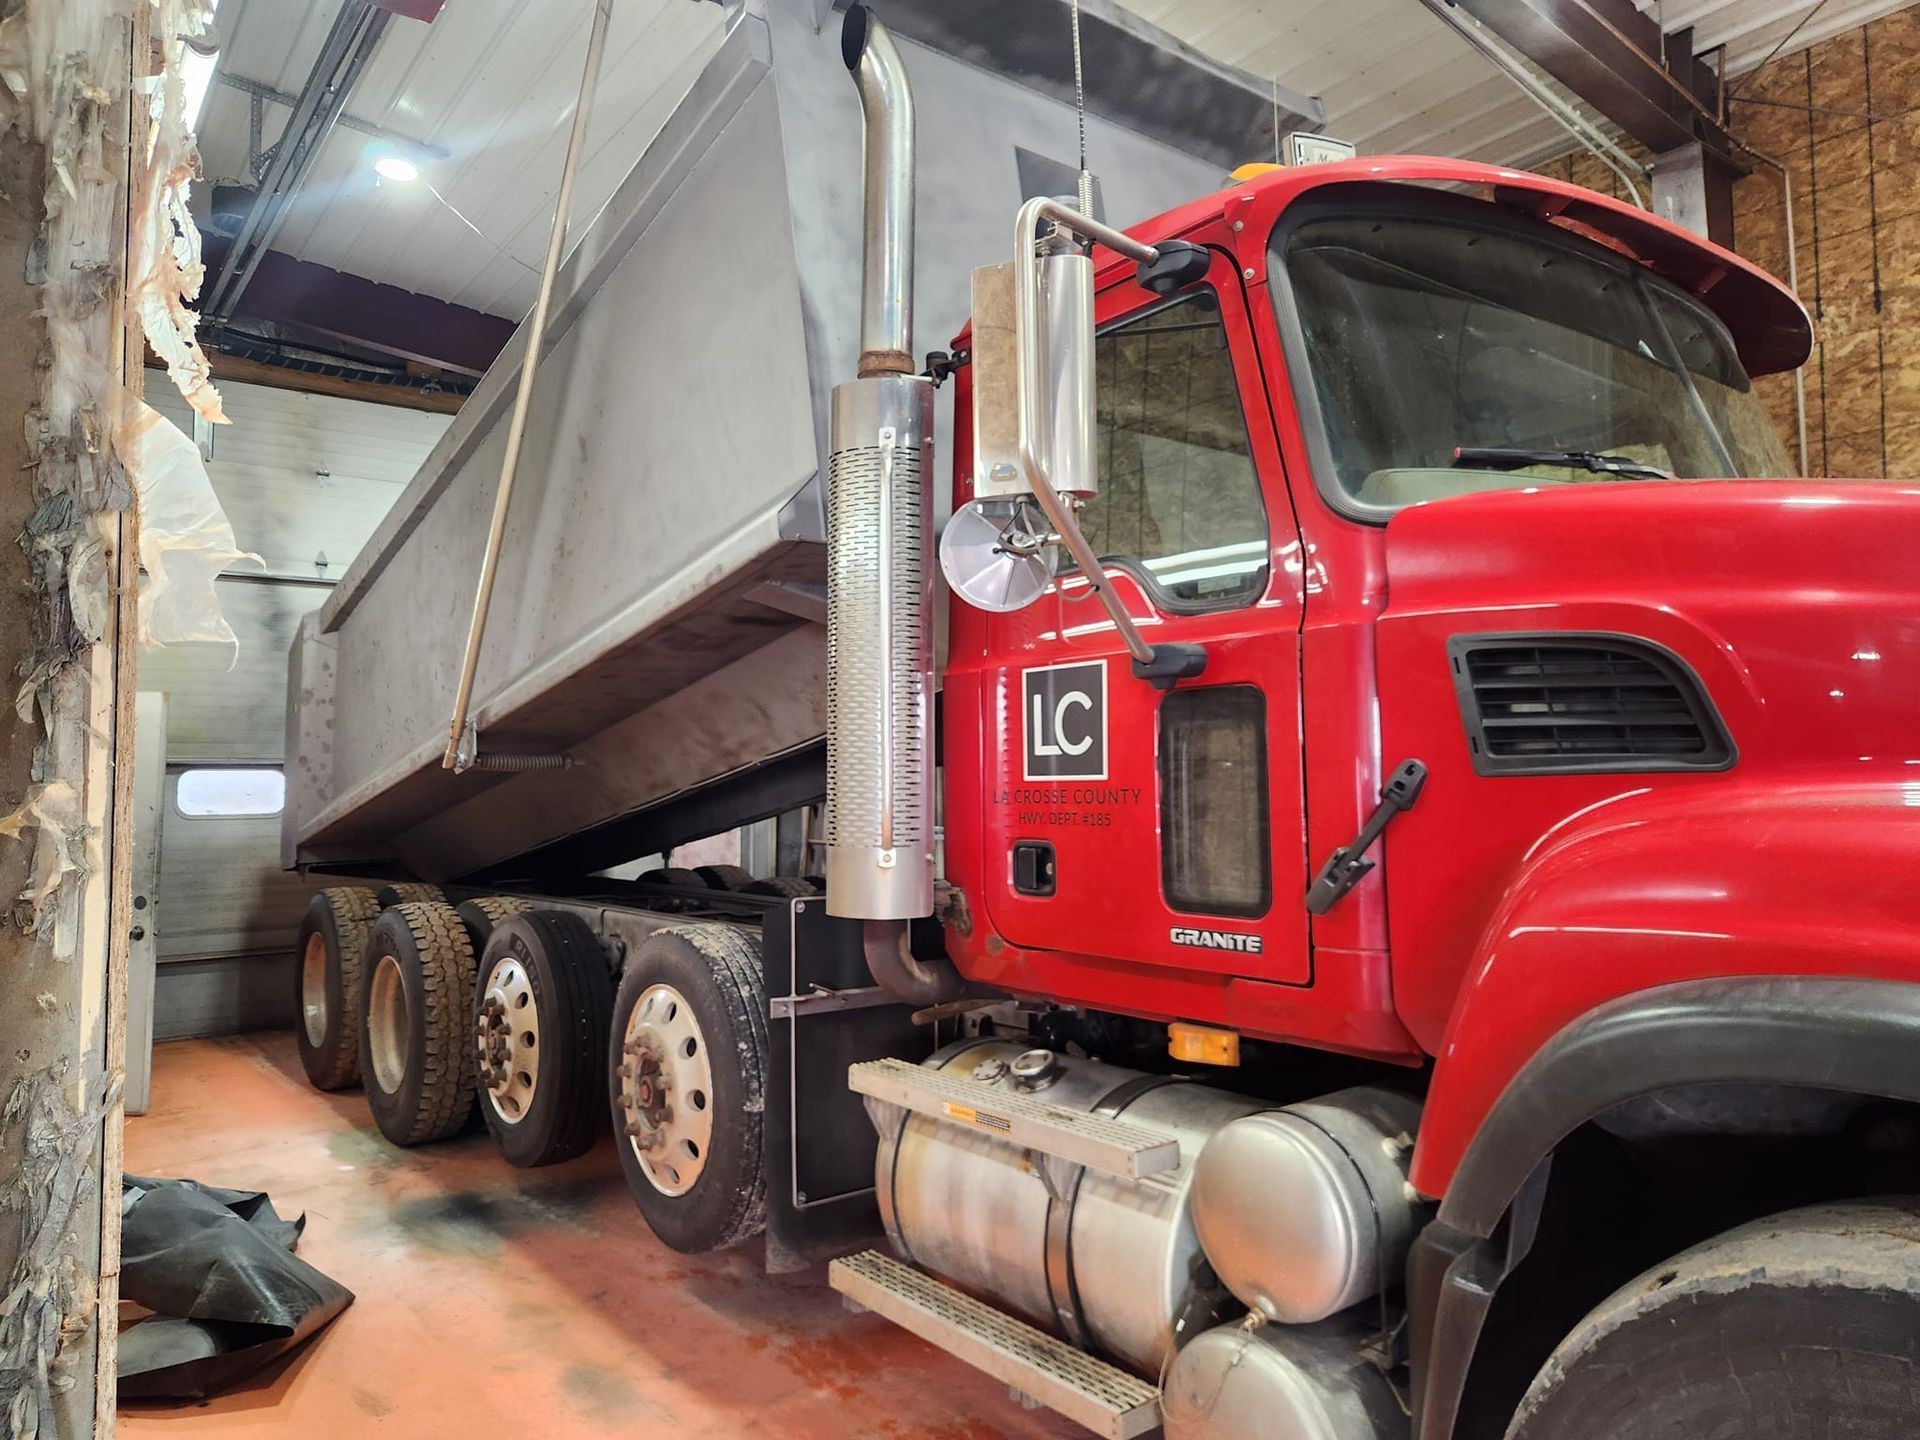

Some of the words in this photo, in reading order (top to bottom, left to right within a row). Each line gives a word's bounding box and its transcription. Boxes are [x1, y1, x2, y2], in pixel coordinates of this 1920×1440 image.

[1033, 691, 1093, 756] LC
[993, 789, 1009, 804] LA
[1014, 789, 1066, 804] CROSSE
[1073, 788, 1142, 805] COUNTY
[1018, 812, 1046, 825] HWY.
[1049, 812, 1080, 826] DEPT.
[1082, 812, 1111, 827] #185
